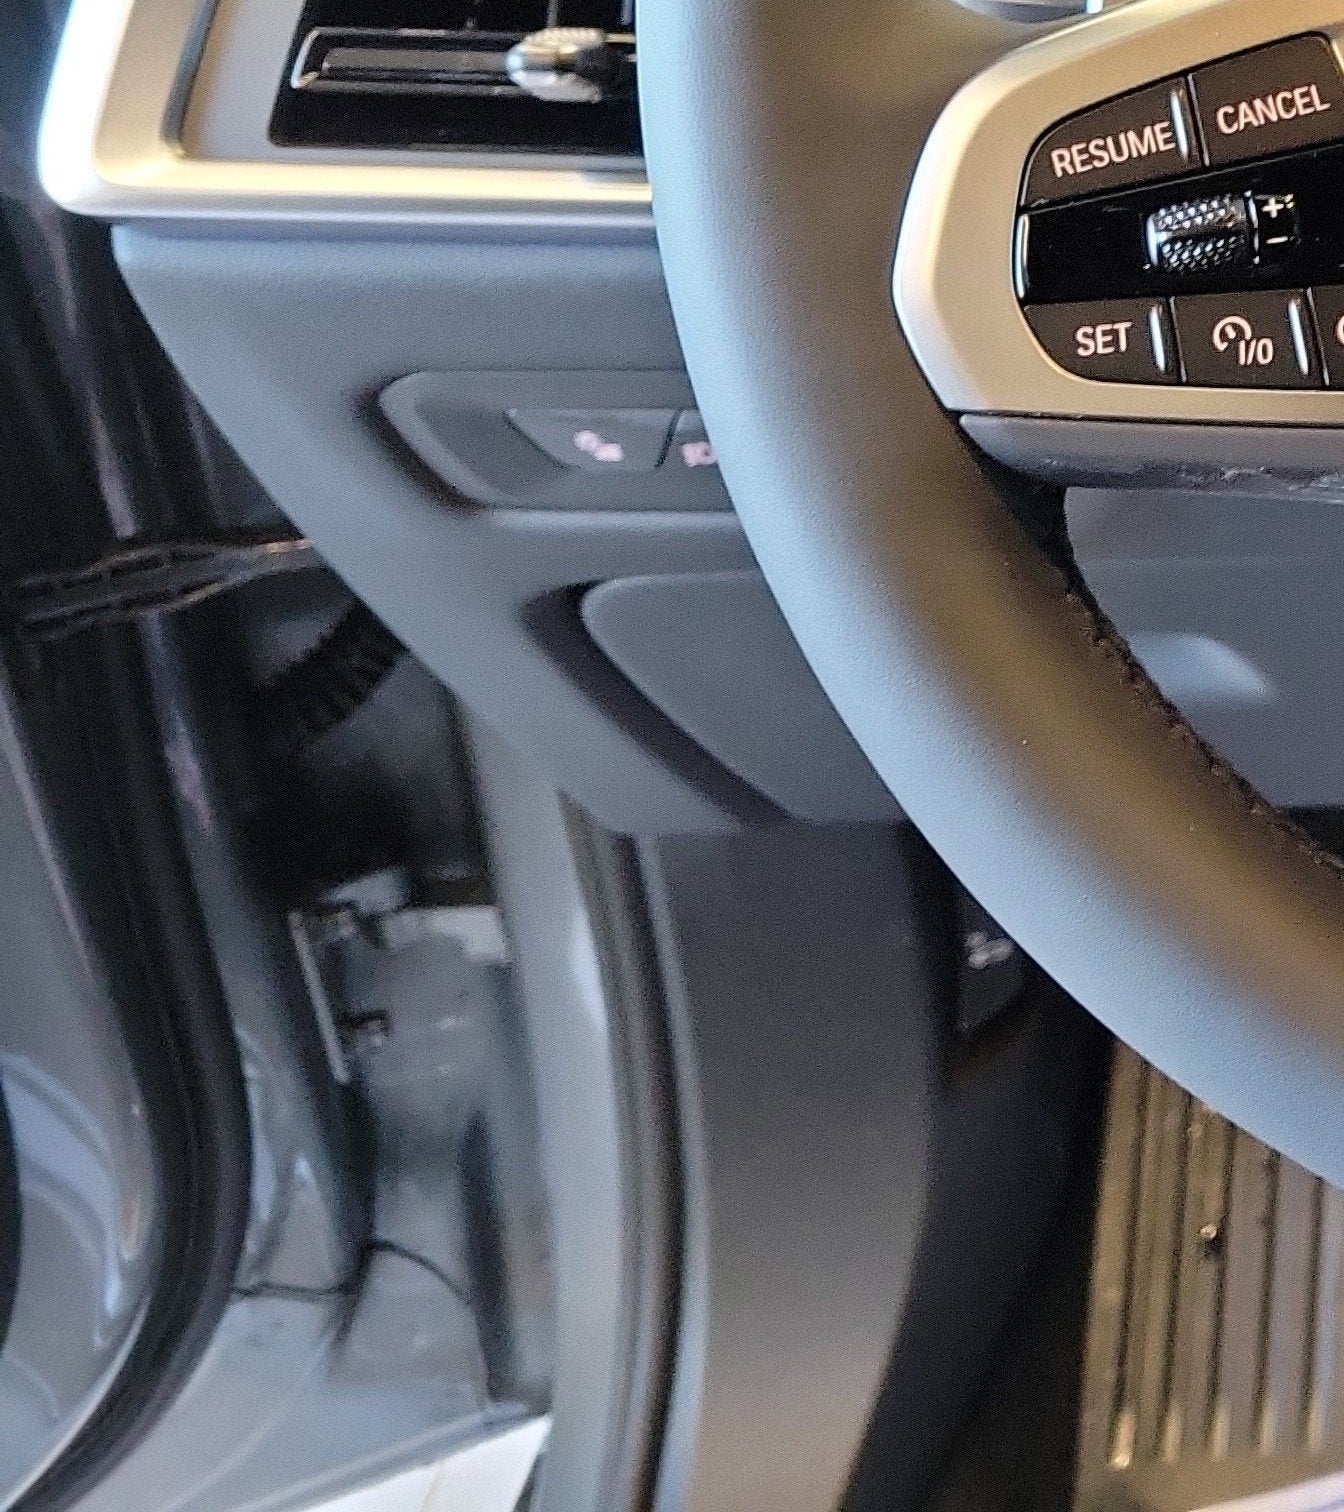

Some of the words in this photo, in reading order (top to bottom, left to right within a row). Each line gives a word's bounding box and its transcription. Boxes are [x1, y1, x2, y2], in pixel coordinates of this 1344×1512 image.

[1216, 84, 1331, 135] CANCEL
[1051, 121, 1176, 178] RESUME
[1075, 321, 1133, 357] SET
